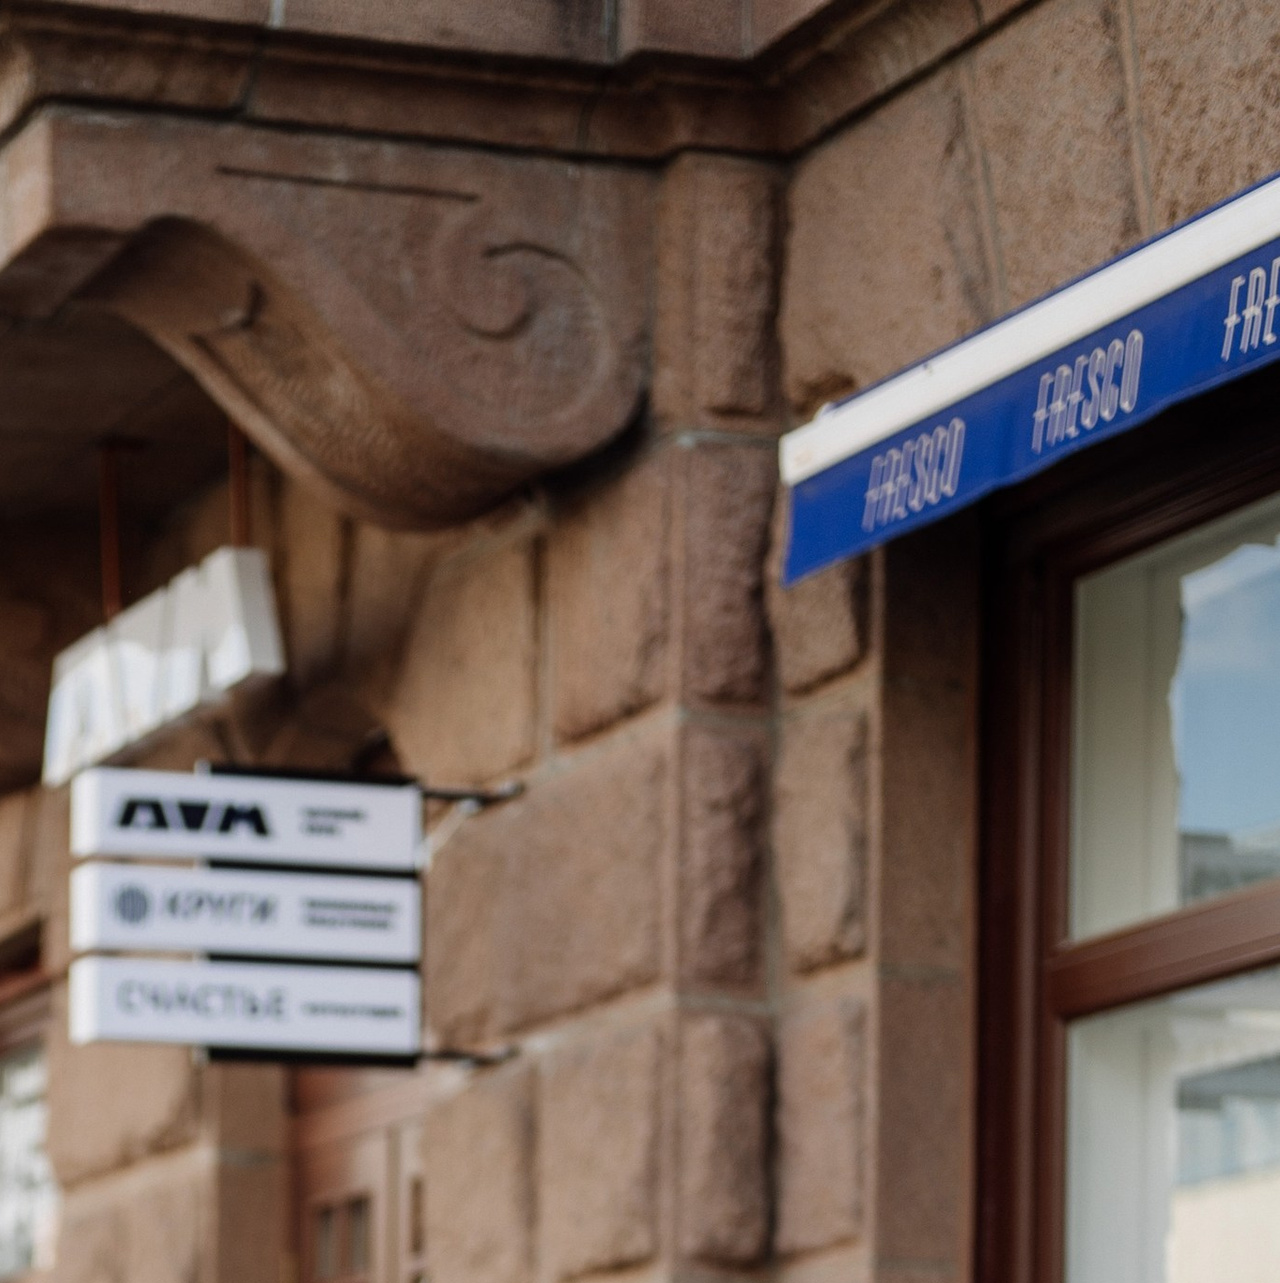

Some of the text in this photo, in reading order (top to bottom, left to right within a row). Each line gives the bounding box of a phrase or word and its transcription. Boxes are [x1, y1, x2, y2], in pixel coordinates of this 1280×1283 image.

[861, 417, 967, 533] FRESCO
[1031, 328, 1144, 455] FRESCO
[116, 977, 289, 1022] СЧАСТЬЕ
